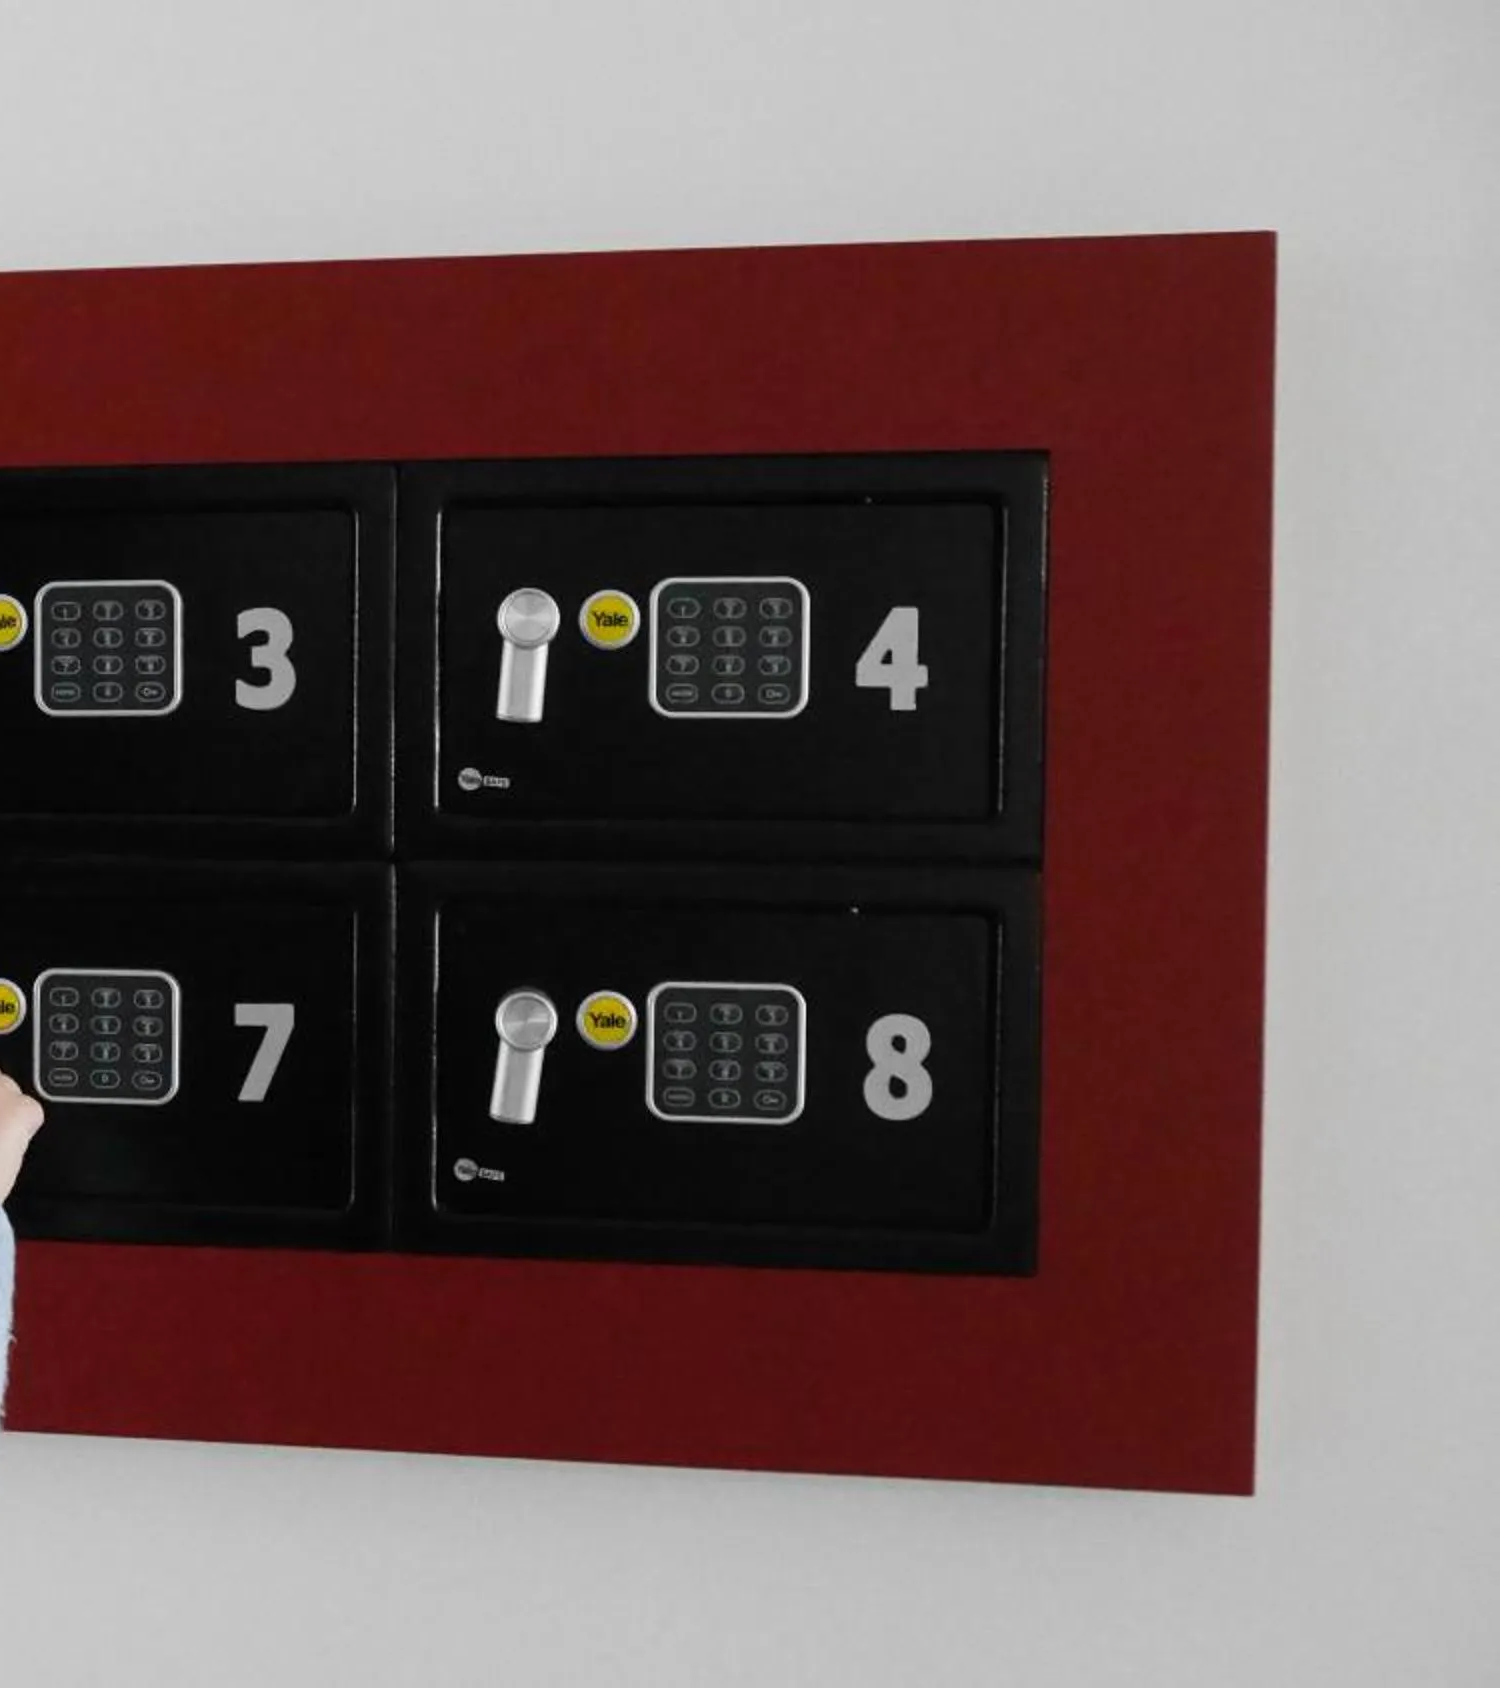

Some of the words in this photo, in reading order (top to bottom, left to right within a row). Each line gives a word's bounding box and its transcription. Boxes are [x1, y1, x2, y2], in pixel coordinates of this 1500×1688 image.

[235, 607, 297, 711] 3
[591, 611, 629, 629] Yale
[855, 606, 929, 711] 4
[234, 1003, 295, 1102] 7
[588, 1011, 627, 1030] Yale
[863, 1013, 933, 1121] 8
